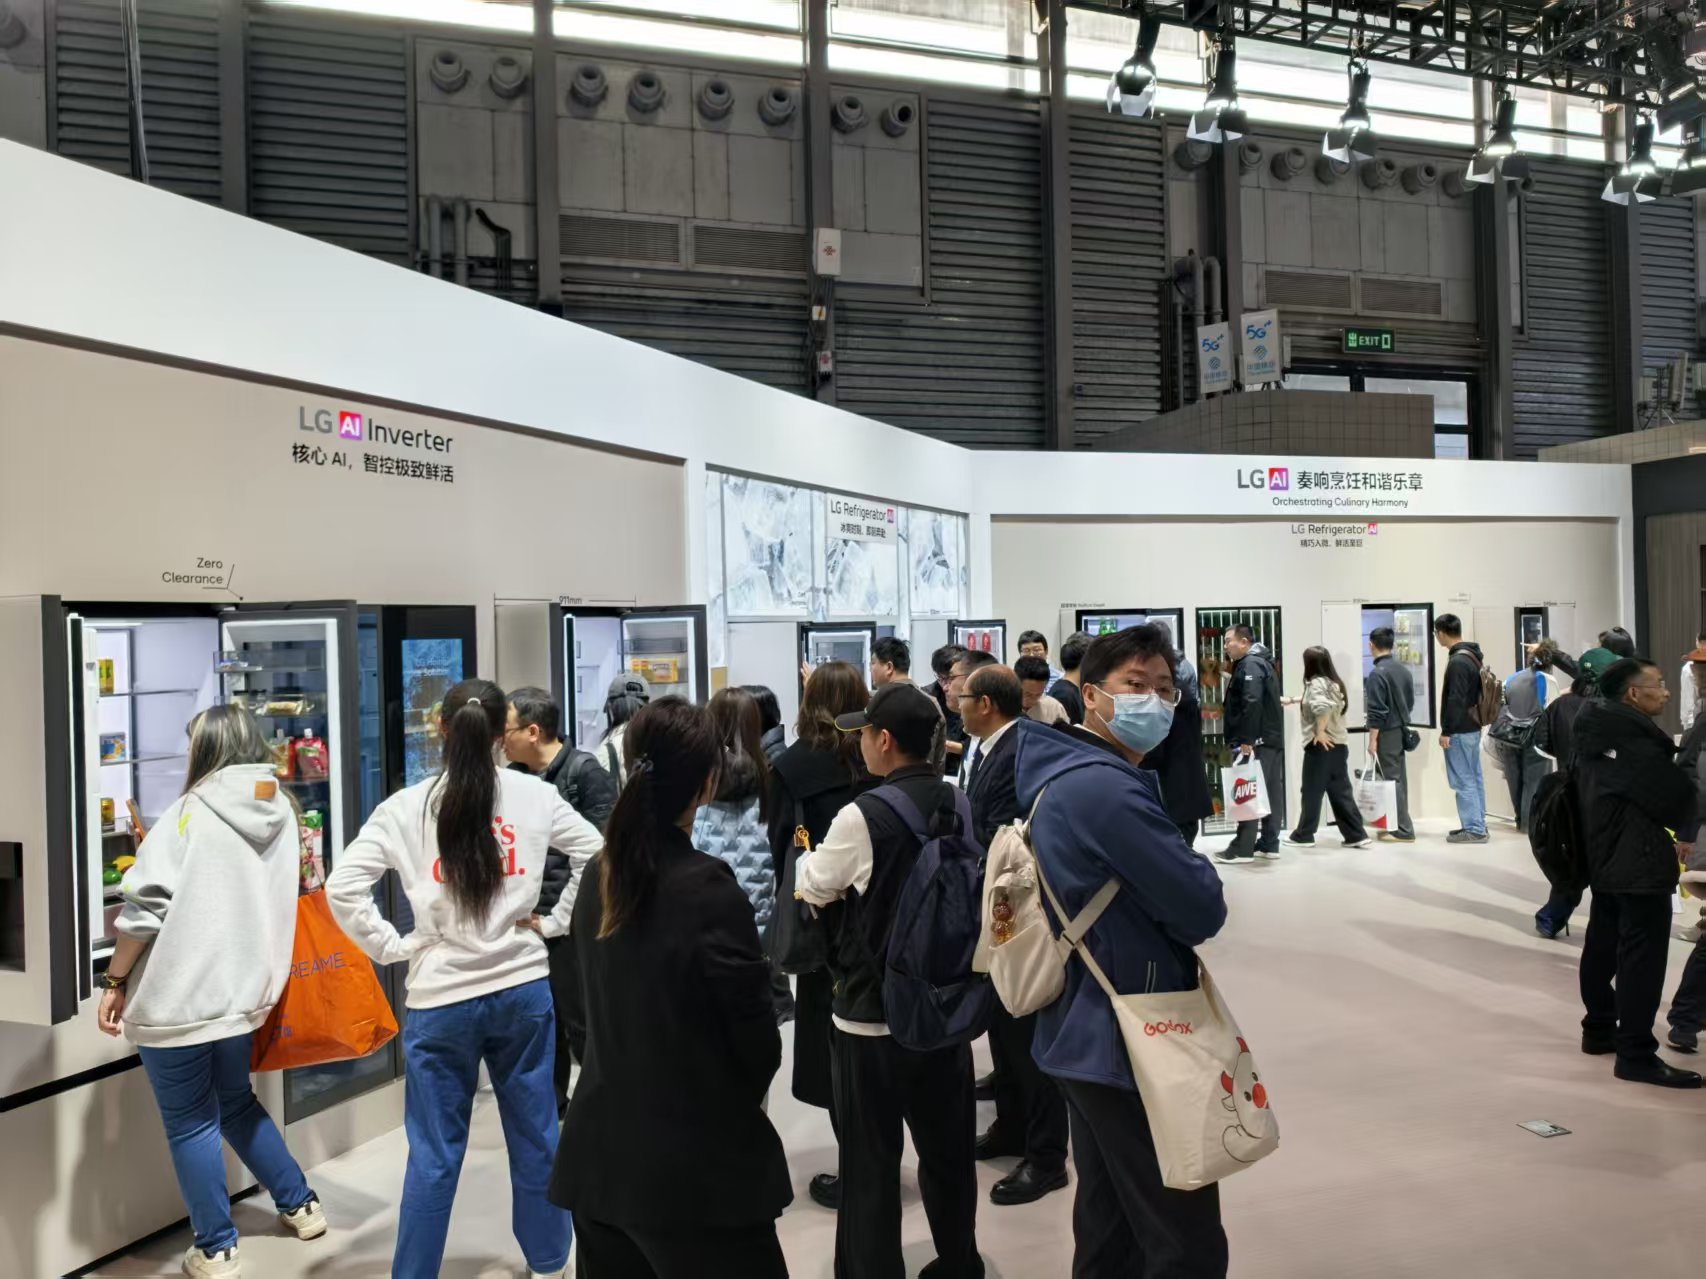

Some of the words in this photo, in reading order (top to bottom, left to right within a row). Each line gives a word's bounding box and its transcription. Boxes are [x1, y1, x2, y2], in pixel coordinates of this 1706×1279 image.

[1359, 336, 1380, 346] EXIT
[299, 406, 333, 434] LG
[340, 413, 362, 439] AI
[368, 418, 454, 453] Inverter
[292, 442, 328, 467] 核心
[1237, 469, 1265, 489] LG
[1270, 471, 1287, 488] AI
[1297, 471, 1424, 491] 奏响烹饪和谐乐章
[830, 500, 842, 514] LG
[843, 502, 887, 521] Refrigerator
[1272, 497, 1333, 508] Orchestrating
[1334, 497, 1370, 508] Culinary
[1371, 499, 1409, 509] Harmony
[1291, 524, 1305, 535] LG
[1308, 524, 1366, 536] Refrigerator
[1368, 523, 1378, 535] AI
[196, 557, 223, 569] Zero
[161, 571, 224, 585] Clearance
[559, 595, 583, 605] 911mm
[1234, 782, 1257, 799] AWE
[289, 951, 346, 979] REAME
